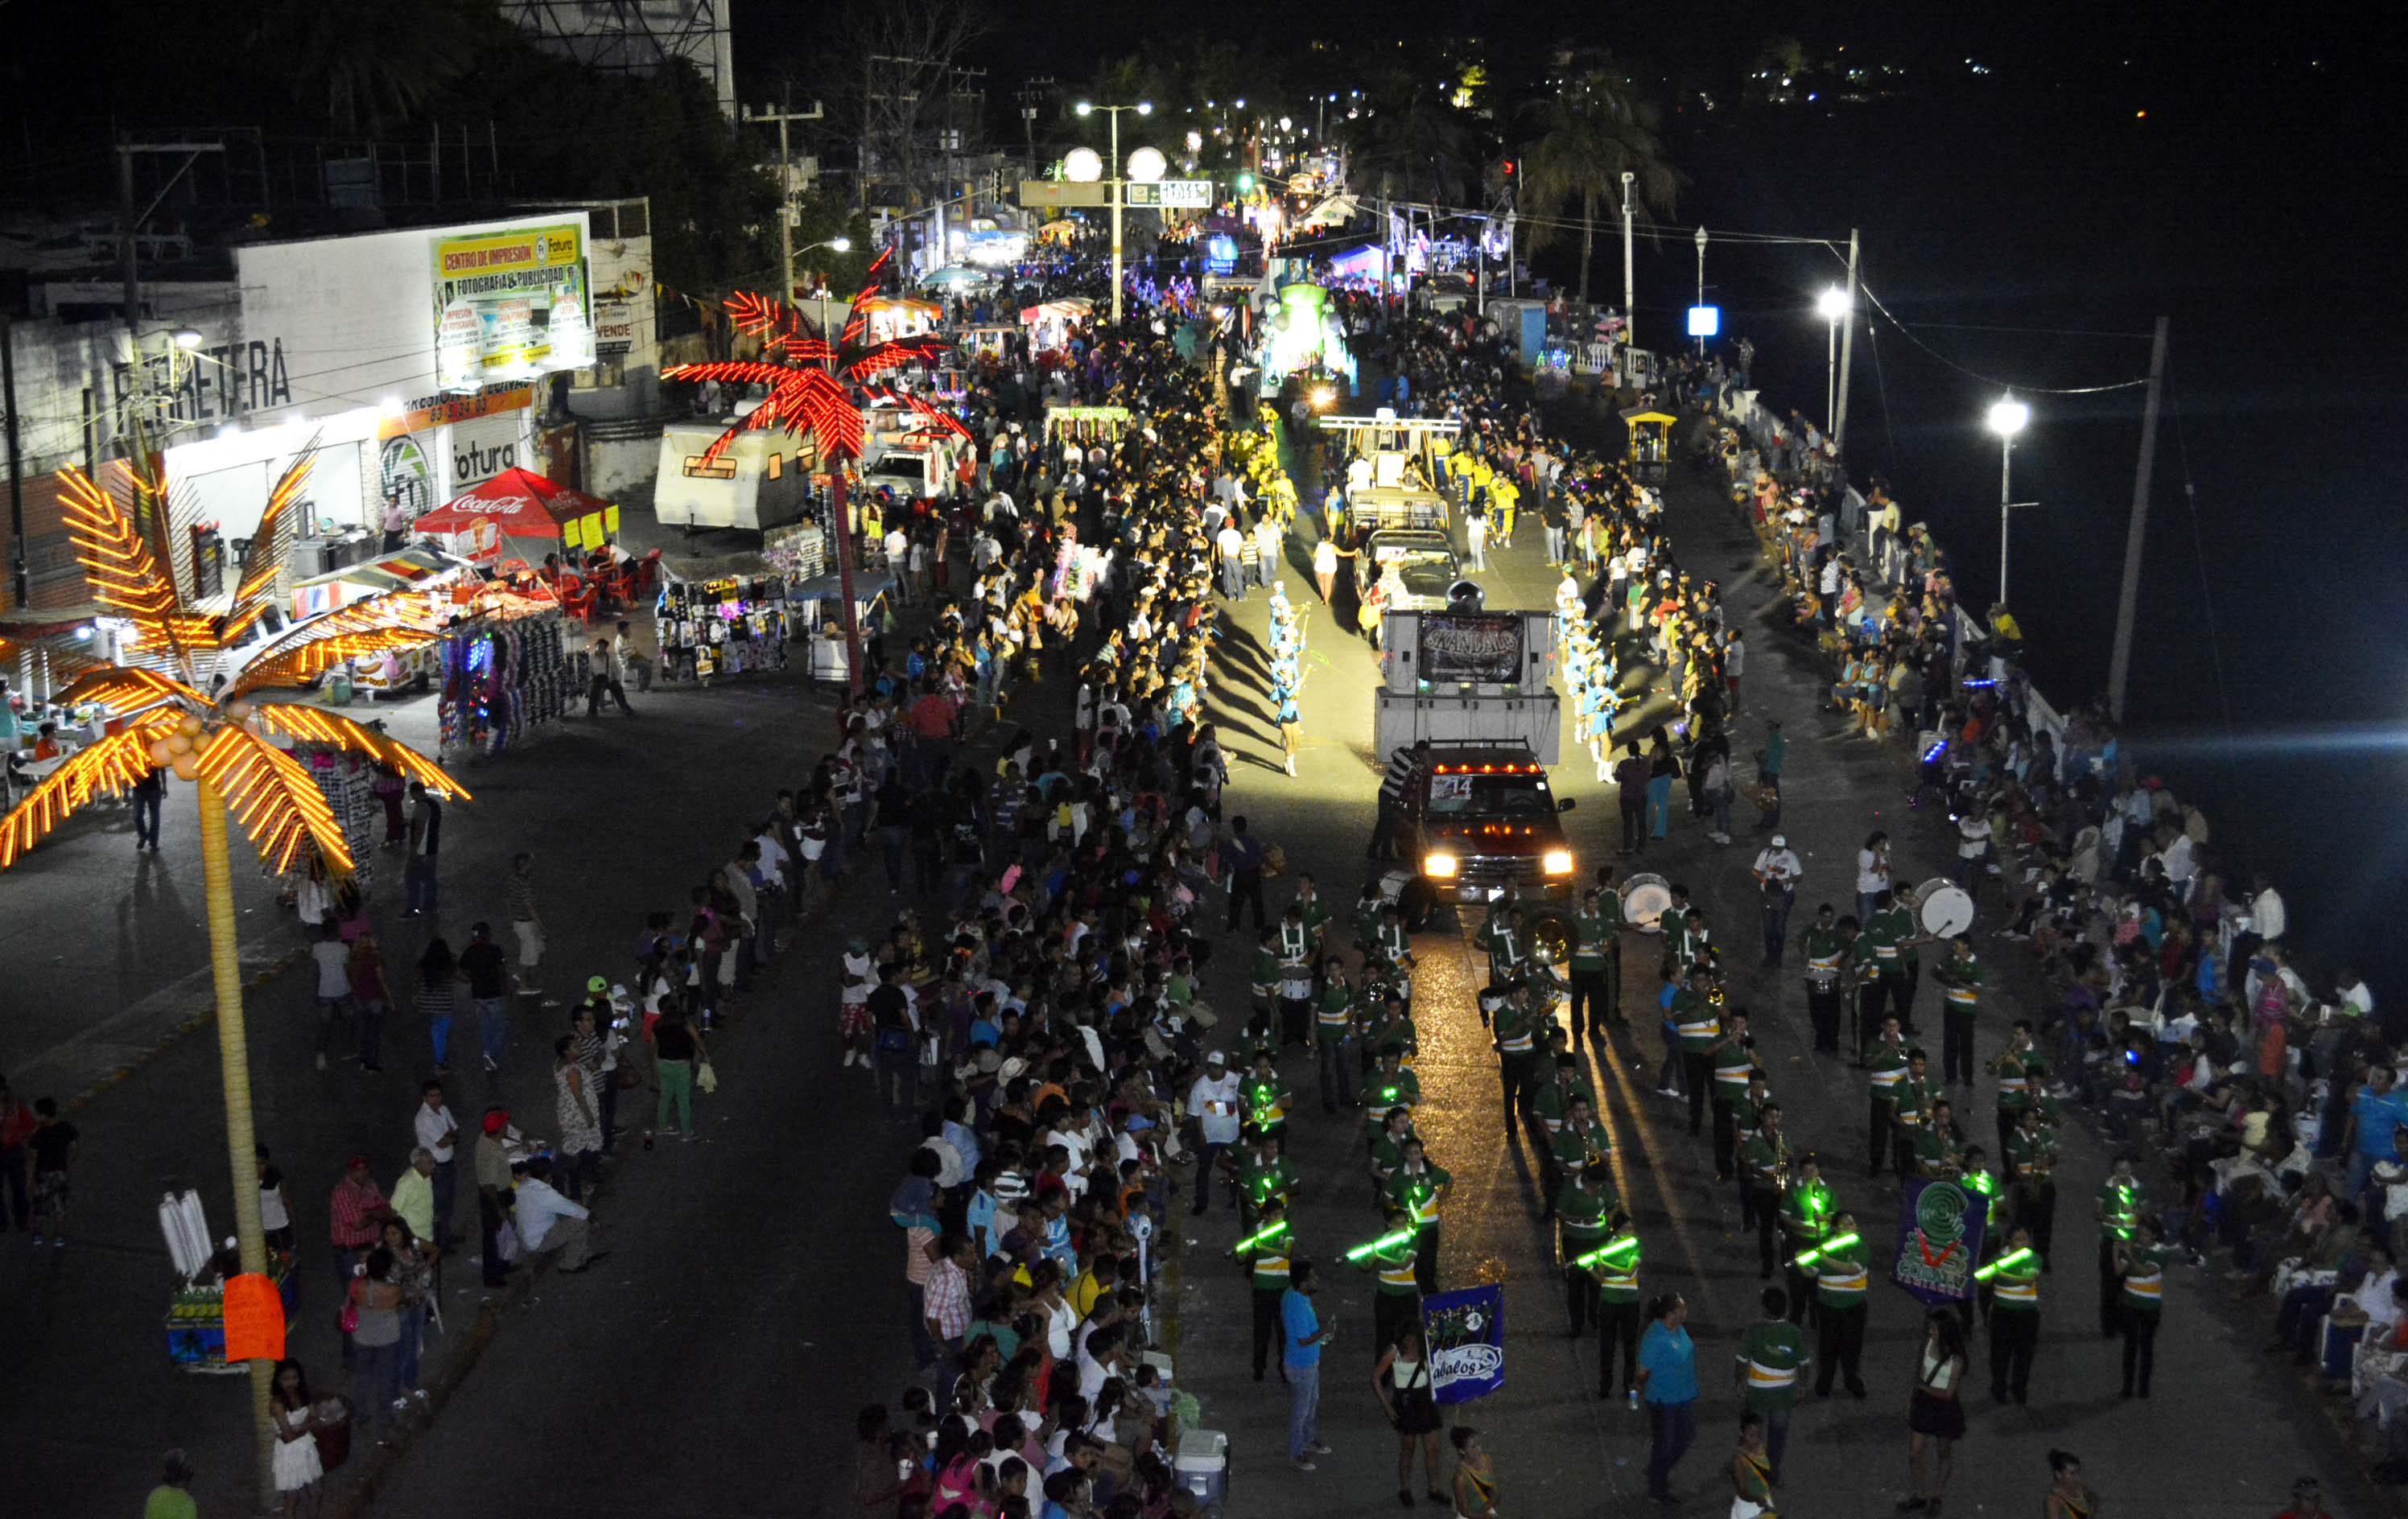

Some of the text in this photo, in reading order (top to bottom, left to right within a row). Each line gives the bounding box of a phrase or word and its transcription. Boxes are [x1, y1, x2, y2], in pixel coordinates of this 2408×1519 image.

[444, 251, 476, 271] CENTRO
[477, 249, 488, 266] DE
[507, 272, 517, 290] &
[517, 267, 563, 287] PUBLICIDAD
[596, 323, 631, 338] VENDE
[453, 440, 515, 480] otura
